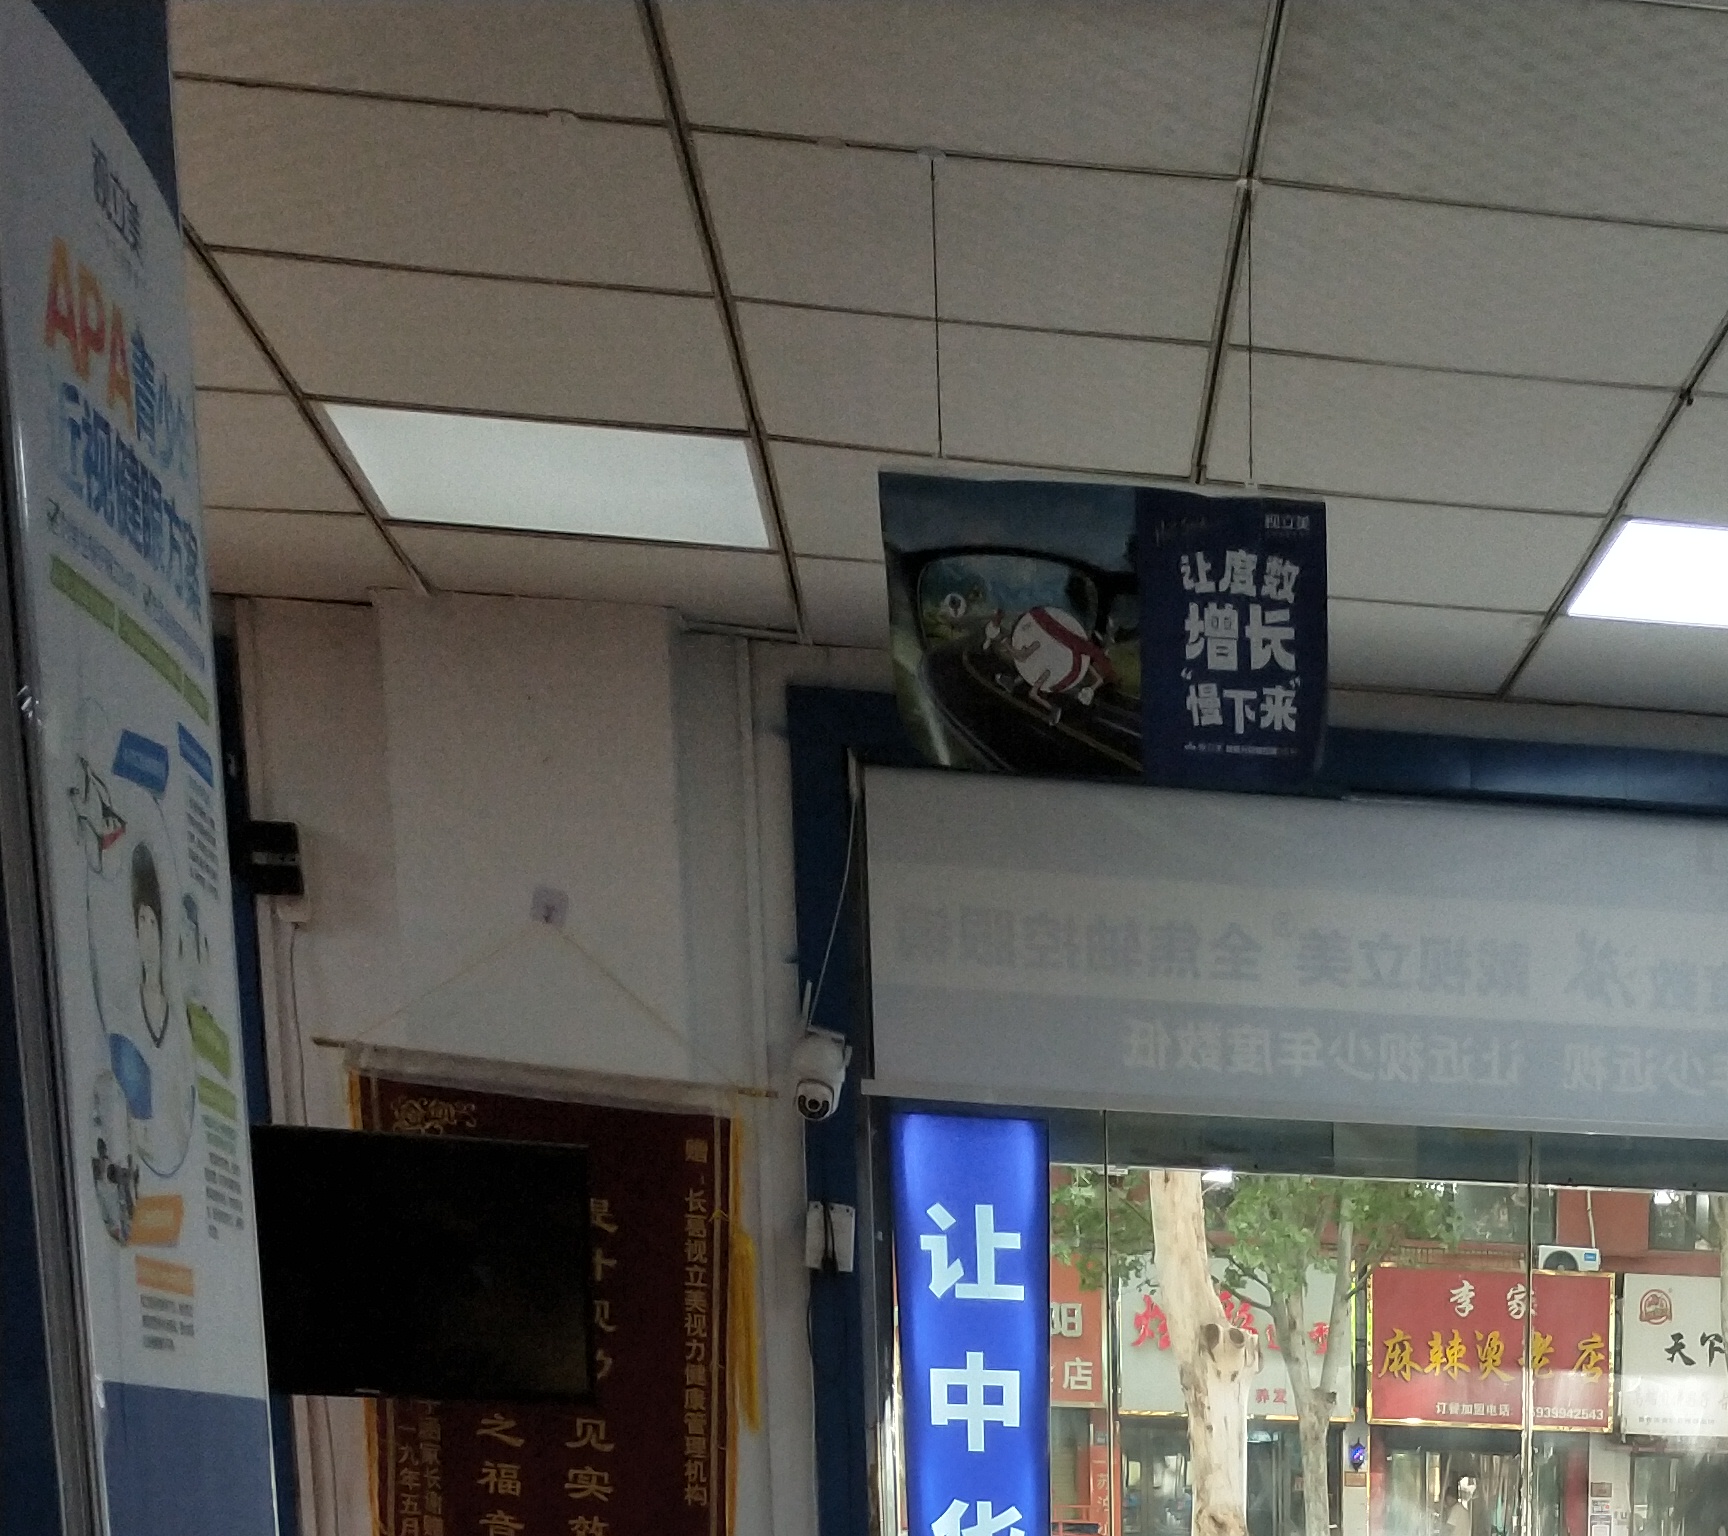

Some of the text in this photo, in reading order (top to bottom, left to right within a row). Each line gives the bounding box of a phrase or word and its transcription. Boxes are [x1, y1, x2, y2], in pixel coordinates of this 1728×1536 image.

[1179, 549, 1300, 603] 让度数
[1184, 601, 1297, 671] 增长
[1378, 1327, 1606, 1384] 麻辣烫老店
